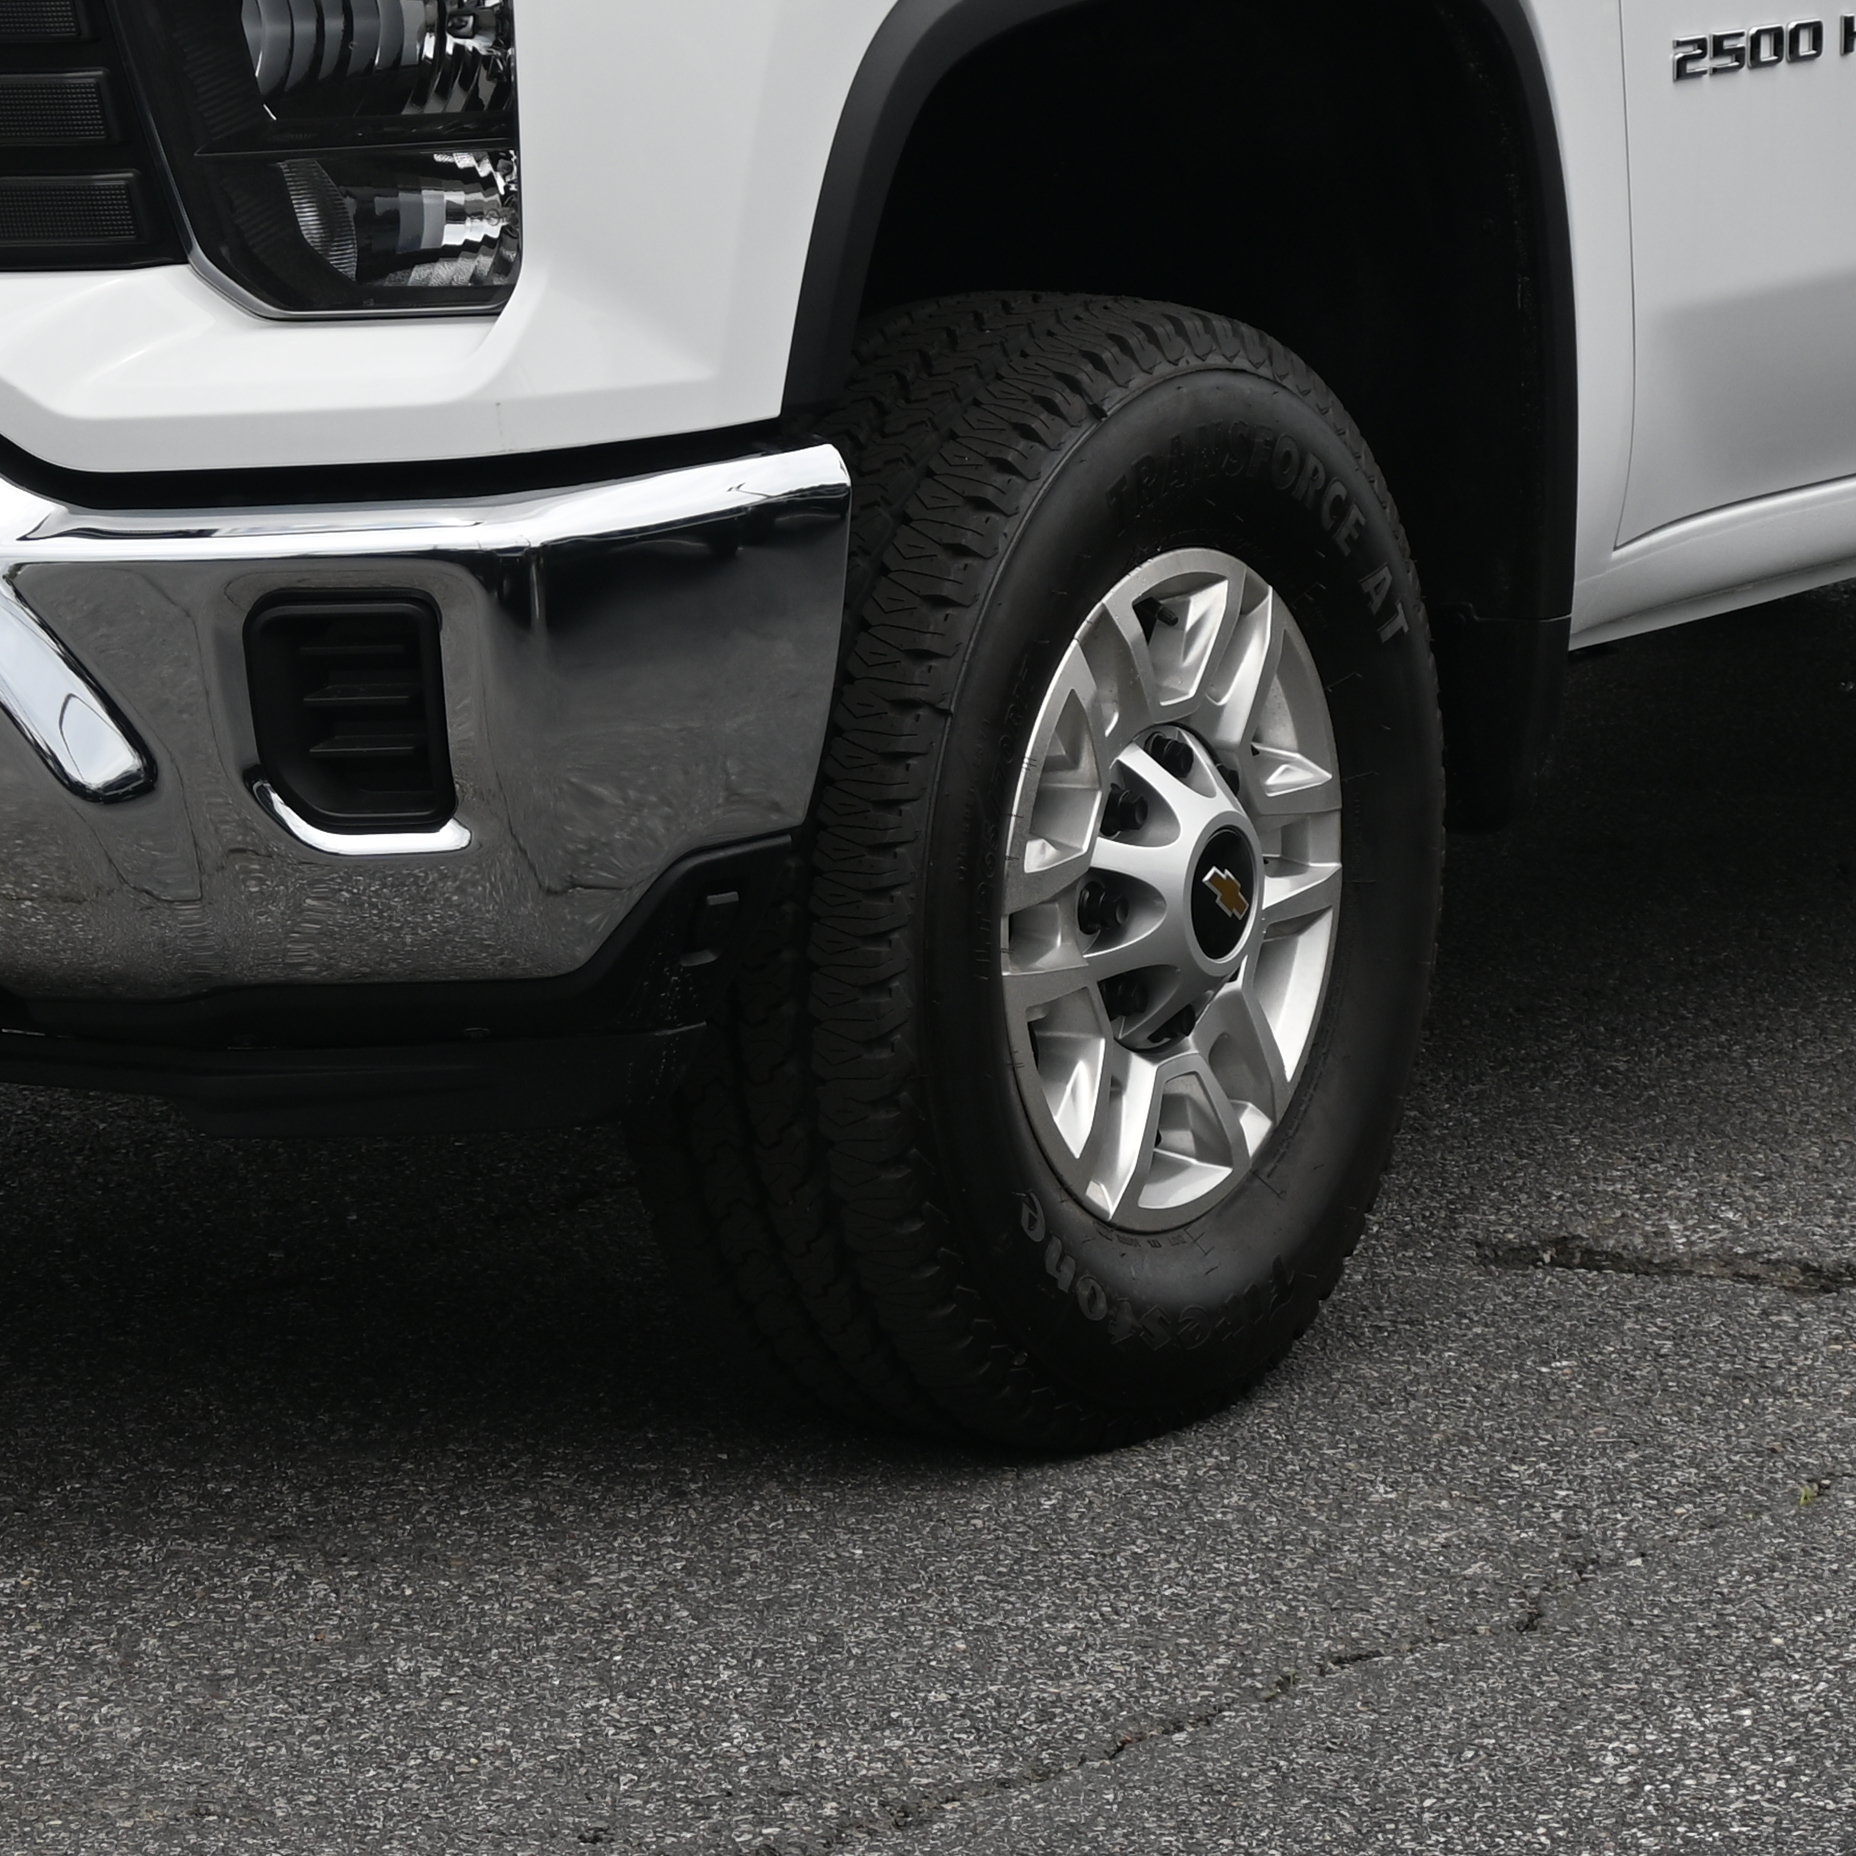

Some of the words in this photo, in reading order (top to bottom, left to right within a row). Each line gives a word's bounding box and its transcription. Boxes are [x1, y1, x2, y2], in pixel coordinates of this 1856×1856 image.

[1672, 17, 1824, 82] 2500
[1105, 420, 1367, 558] TRANSFORCE
[1357, 562, 1410, 644] AT
[1014, 1191, 1295, 1352] Firestone
